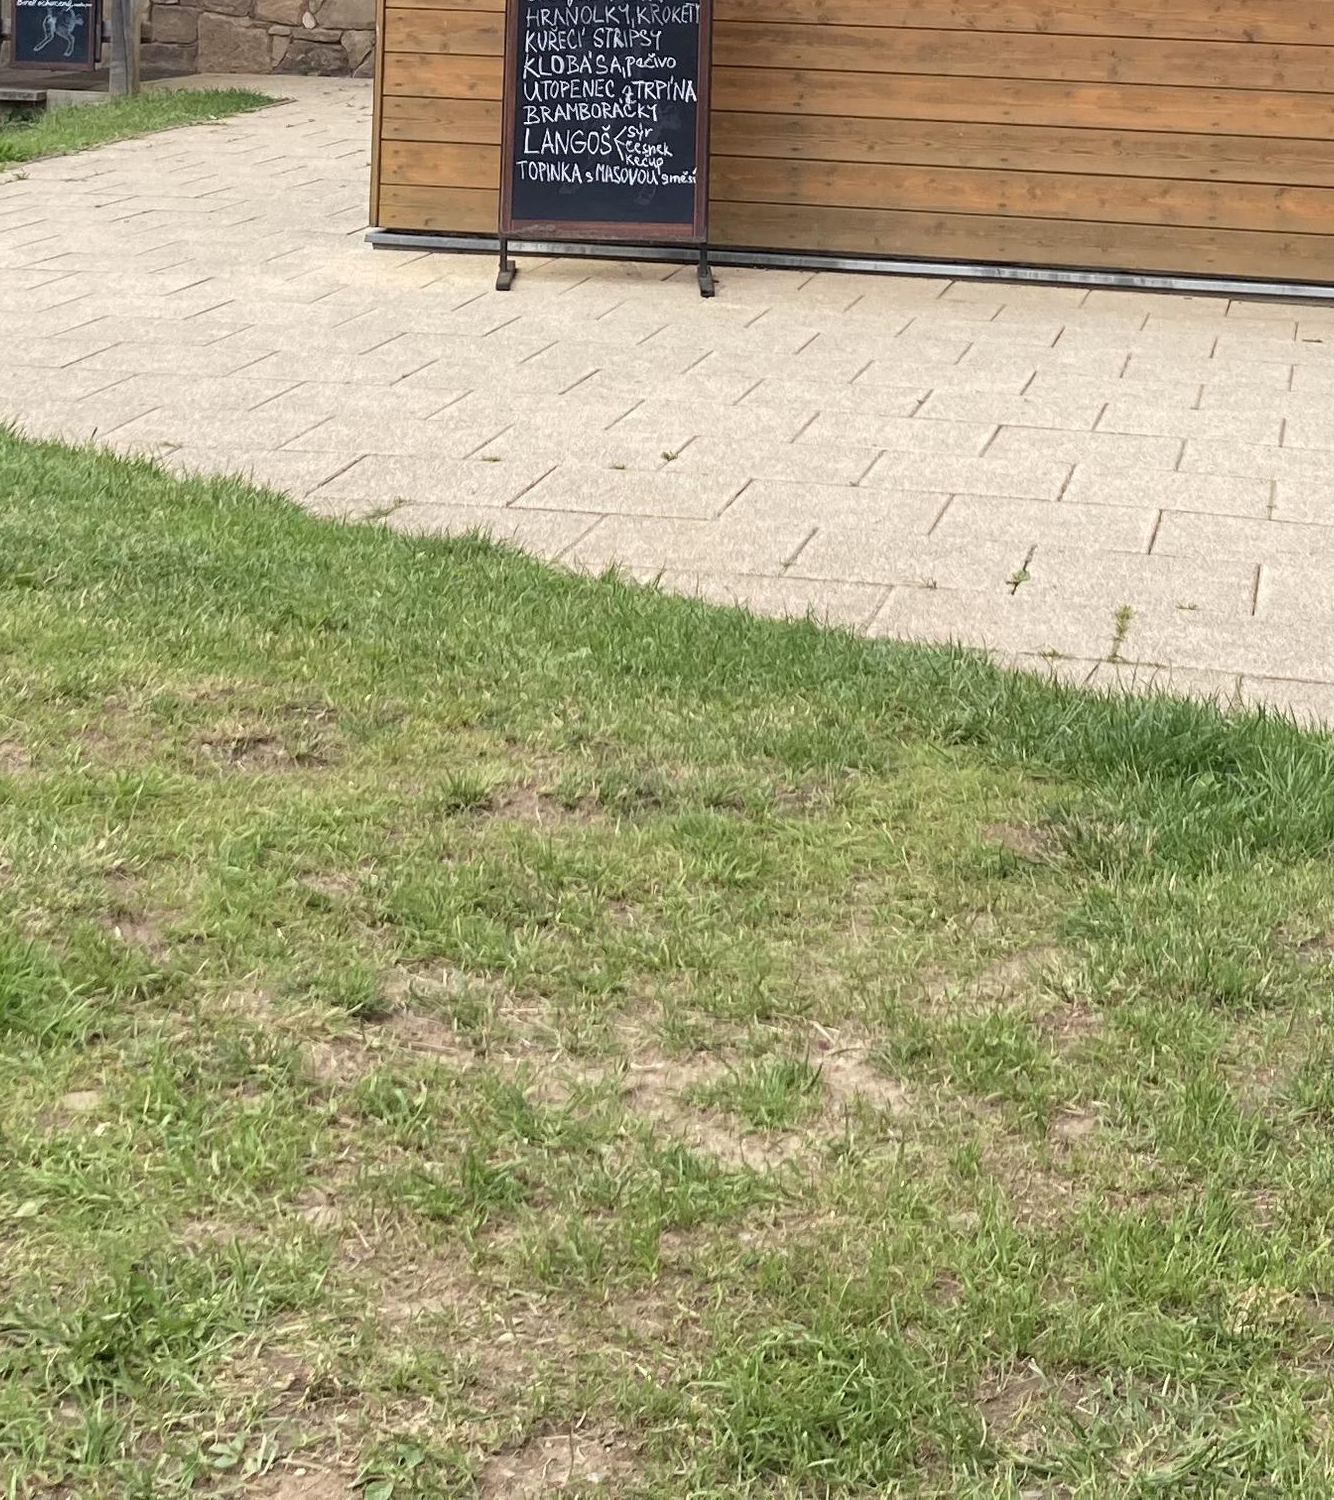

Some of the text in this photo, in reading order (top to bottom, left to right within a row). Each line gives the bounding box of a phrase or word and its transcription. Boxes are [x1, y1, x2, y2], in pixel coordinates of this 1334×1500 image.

[525, 27, 661, 52] KUŘECÍ STRIPSY
[524, 79, 615, 101] UTOPENEC
[524, 125, 612, 155] LANGOŠ
[516, 160, 582, 184] TOPINKA
